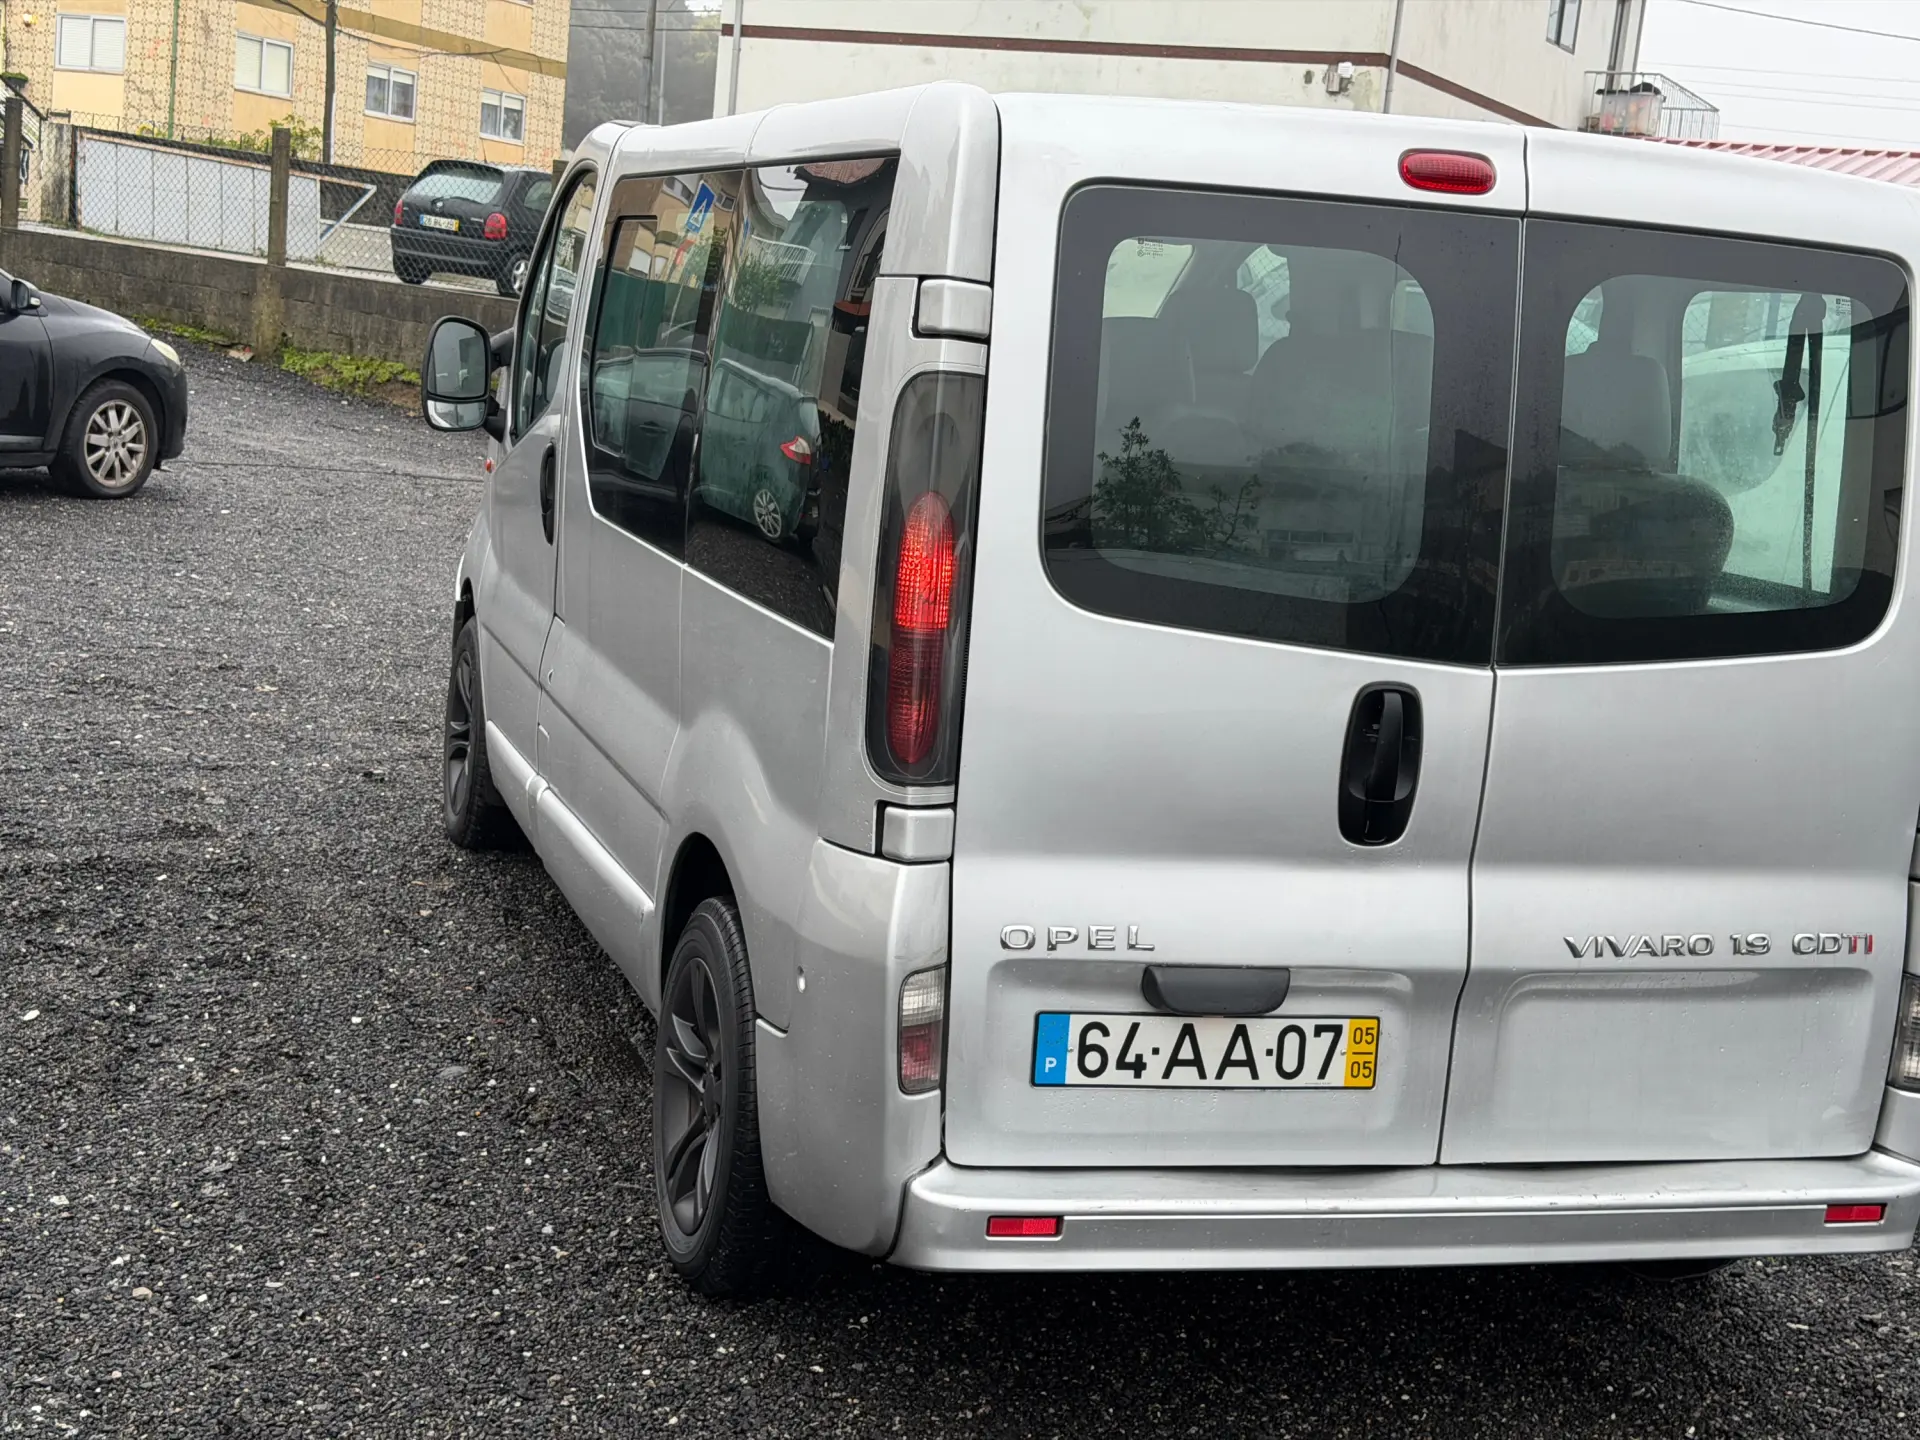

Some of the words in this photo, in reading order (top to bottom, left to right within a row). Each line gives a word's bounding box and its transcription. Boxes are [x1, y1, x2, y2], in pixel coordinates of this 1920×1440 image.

[1000, 924, 1155, 951] OPEL
[1563, 933, 1715, 958] VIVARO
[1730, 932, 1772, 956] 1.9
[1791, 932, 1874, 955] CDTI
[1353, 1026, 1375, 1045] 05
[1044, 1057, 1057, 1073] P
[1350, 1061, 1372, 1079] 05
